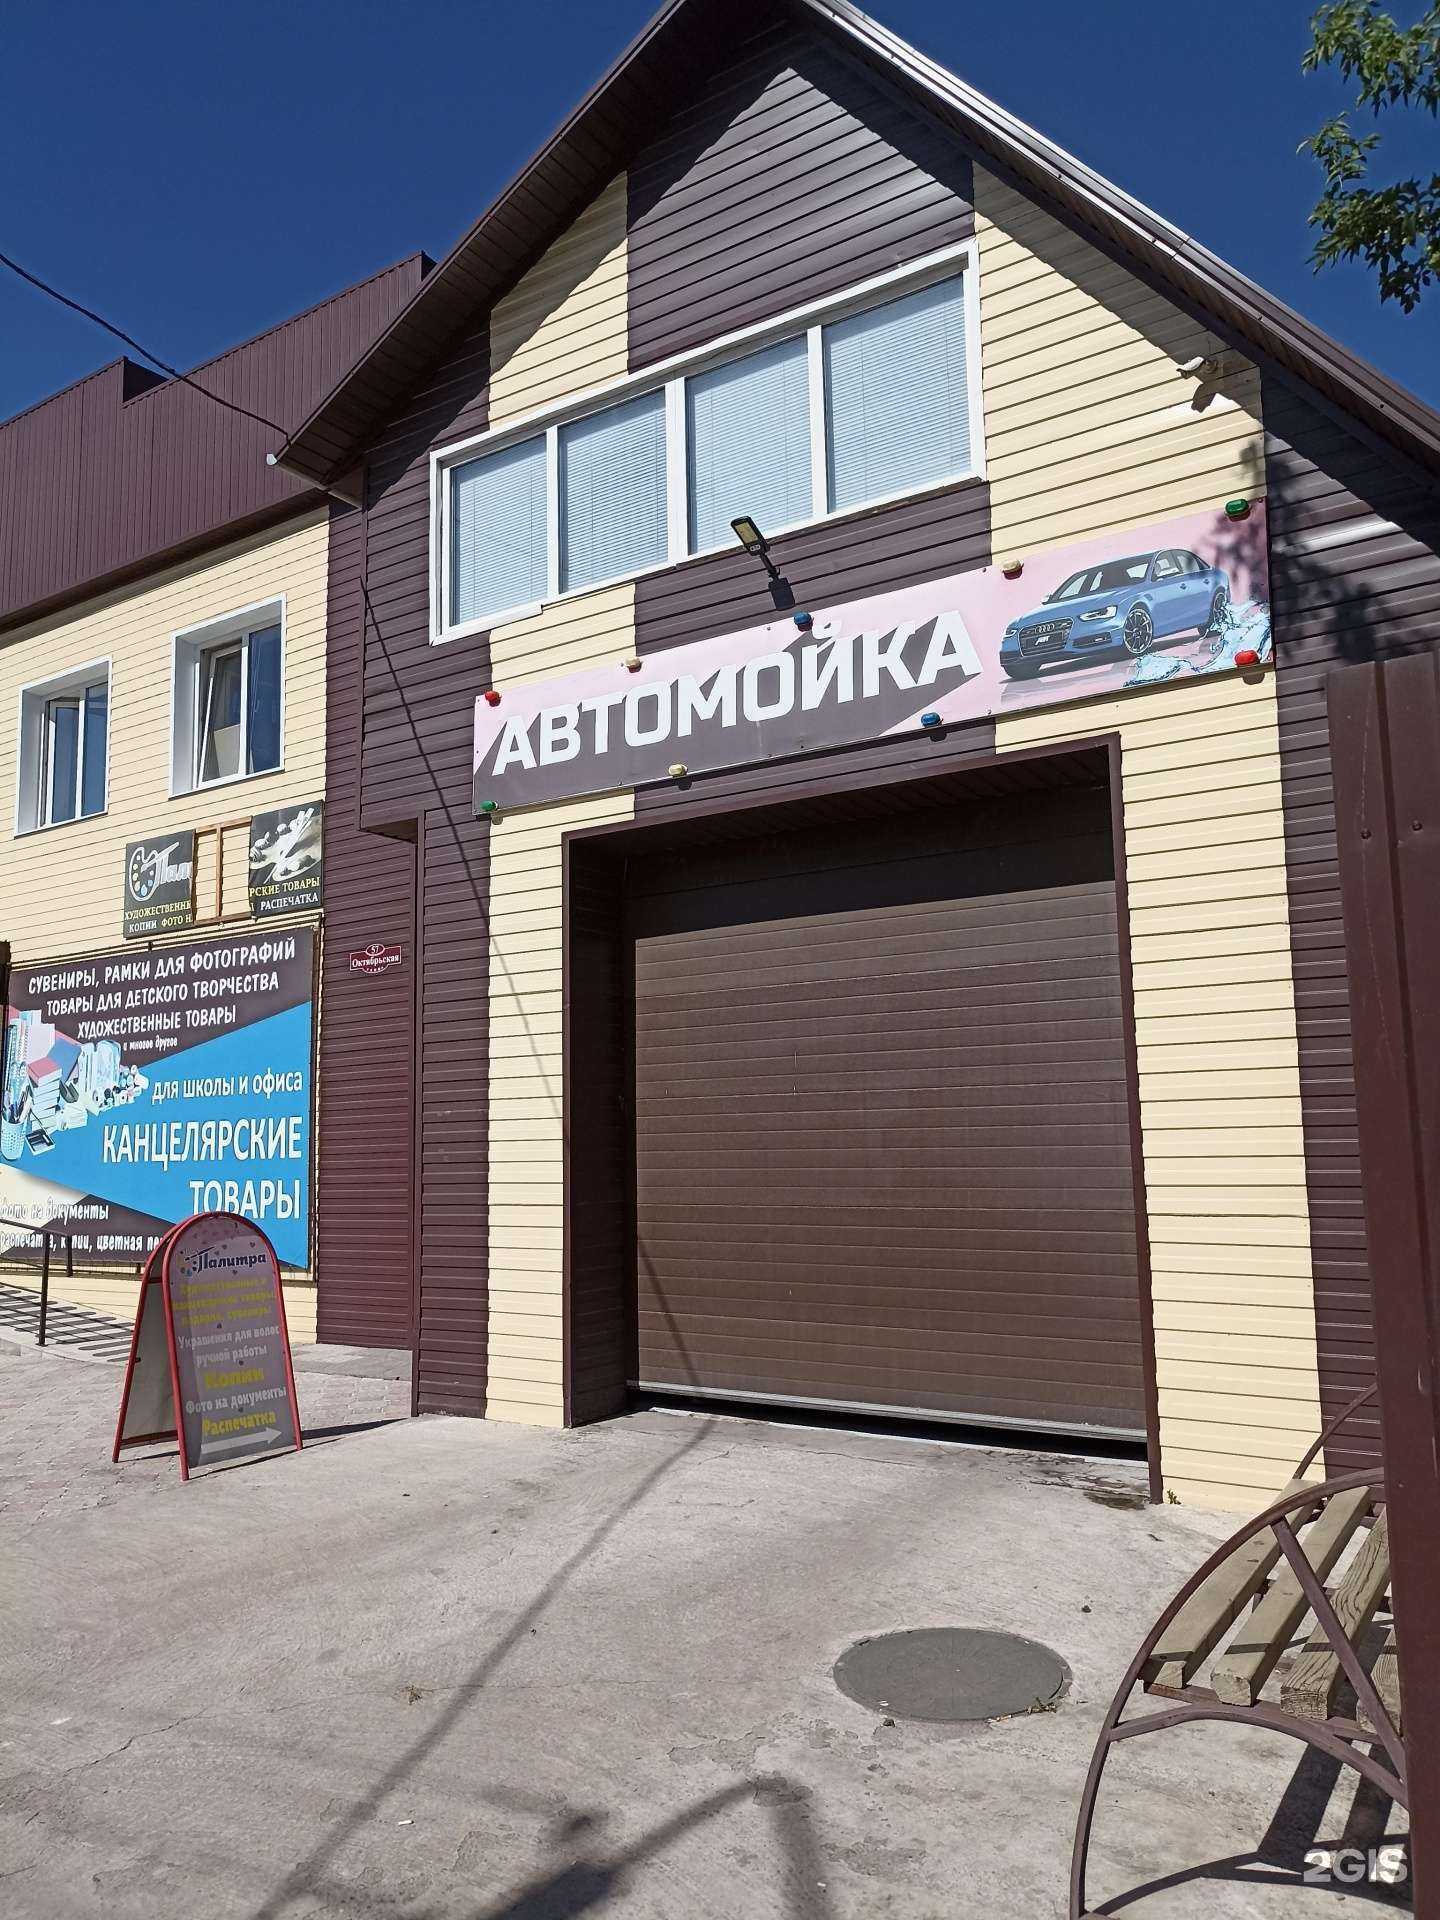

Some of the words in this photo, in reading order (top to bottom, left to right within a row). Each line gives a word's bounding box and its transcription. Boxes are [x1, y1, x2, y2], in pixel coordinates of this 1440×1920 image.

[491, 609, 984, 777] АВТОМОЙКА
[282, 876, 321, 892] ТОВАРЫ
[260, 892, 319, 911] РАСПЕЧАТКА
[129, 919, 157, 933] КОПИИ
[161, 915, 183, 928] ФОТО
[28, 967, 100, 995] СУВЕНИРЫ,
[104, 960, 151, 984] РАМКИ
[155, 955, 185, 979] ДЛЯ
[189, 936, 296, 972] ФОТОГРАФИЙ
[352, 954, 399, 967] Октябрьская
[46, 993, 93, 1017] ТОВАРЫ
[96, 990, 122, 1013] ДЛЯ
[125, 984, 188, 1010] ДЕТСКОГО
[192, 971, 279, 998] ТВОРЧЕСТВА
[77, 1012, 181, 1039] ХУДОЖЕСТВЕННЫЕ
[185, 1004, 236, 1027] ТОВАРЫ
[130, 1039, 153, 1050] многое
[155, 1034, 178, 1051] другое
[151, 1080, 179, 1105] для
[183, 1076, 234, 1099] школы
[239, 1076, 249, 1095] и
[252, 1067, 303, 1099] офиса
[103, 1117, 303, 1172] КАНЦЕЛЯРСКИЕ
[45, 1196, 109, 1225] документы
[189, 1179, 300, 1219] ТОВАРЫ
[0, 1231, 57, 1252] распечата,
[60, 1235, 92, 1252] кпии,
[97, 1235, 143, 1252] цветная
[197, 1251, 267, 1273] Палитра
[234, 1330, 252, 1343] для
[232, 1345, 268, 1362] работы
[185, 1400, 213, 1414] Фото
[215, 1397, 228, 1409] на
[231, 1386, 287, 1409] документы
[202, 1412, 277, 1437] Распечатка
